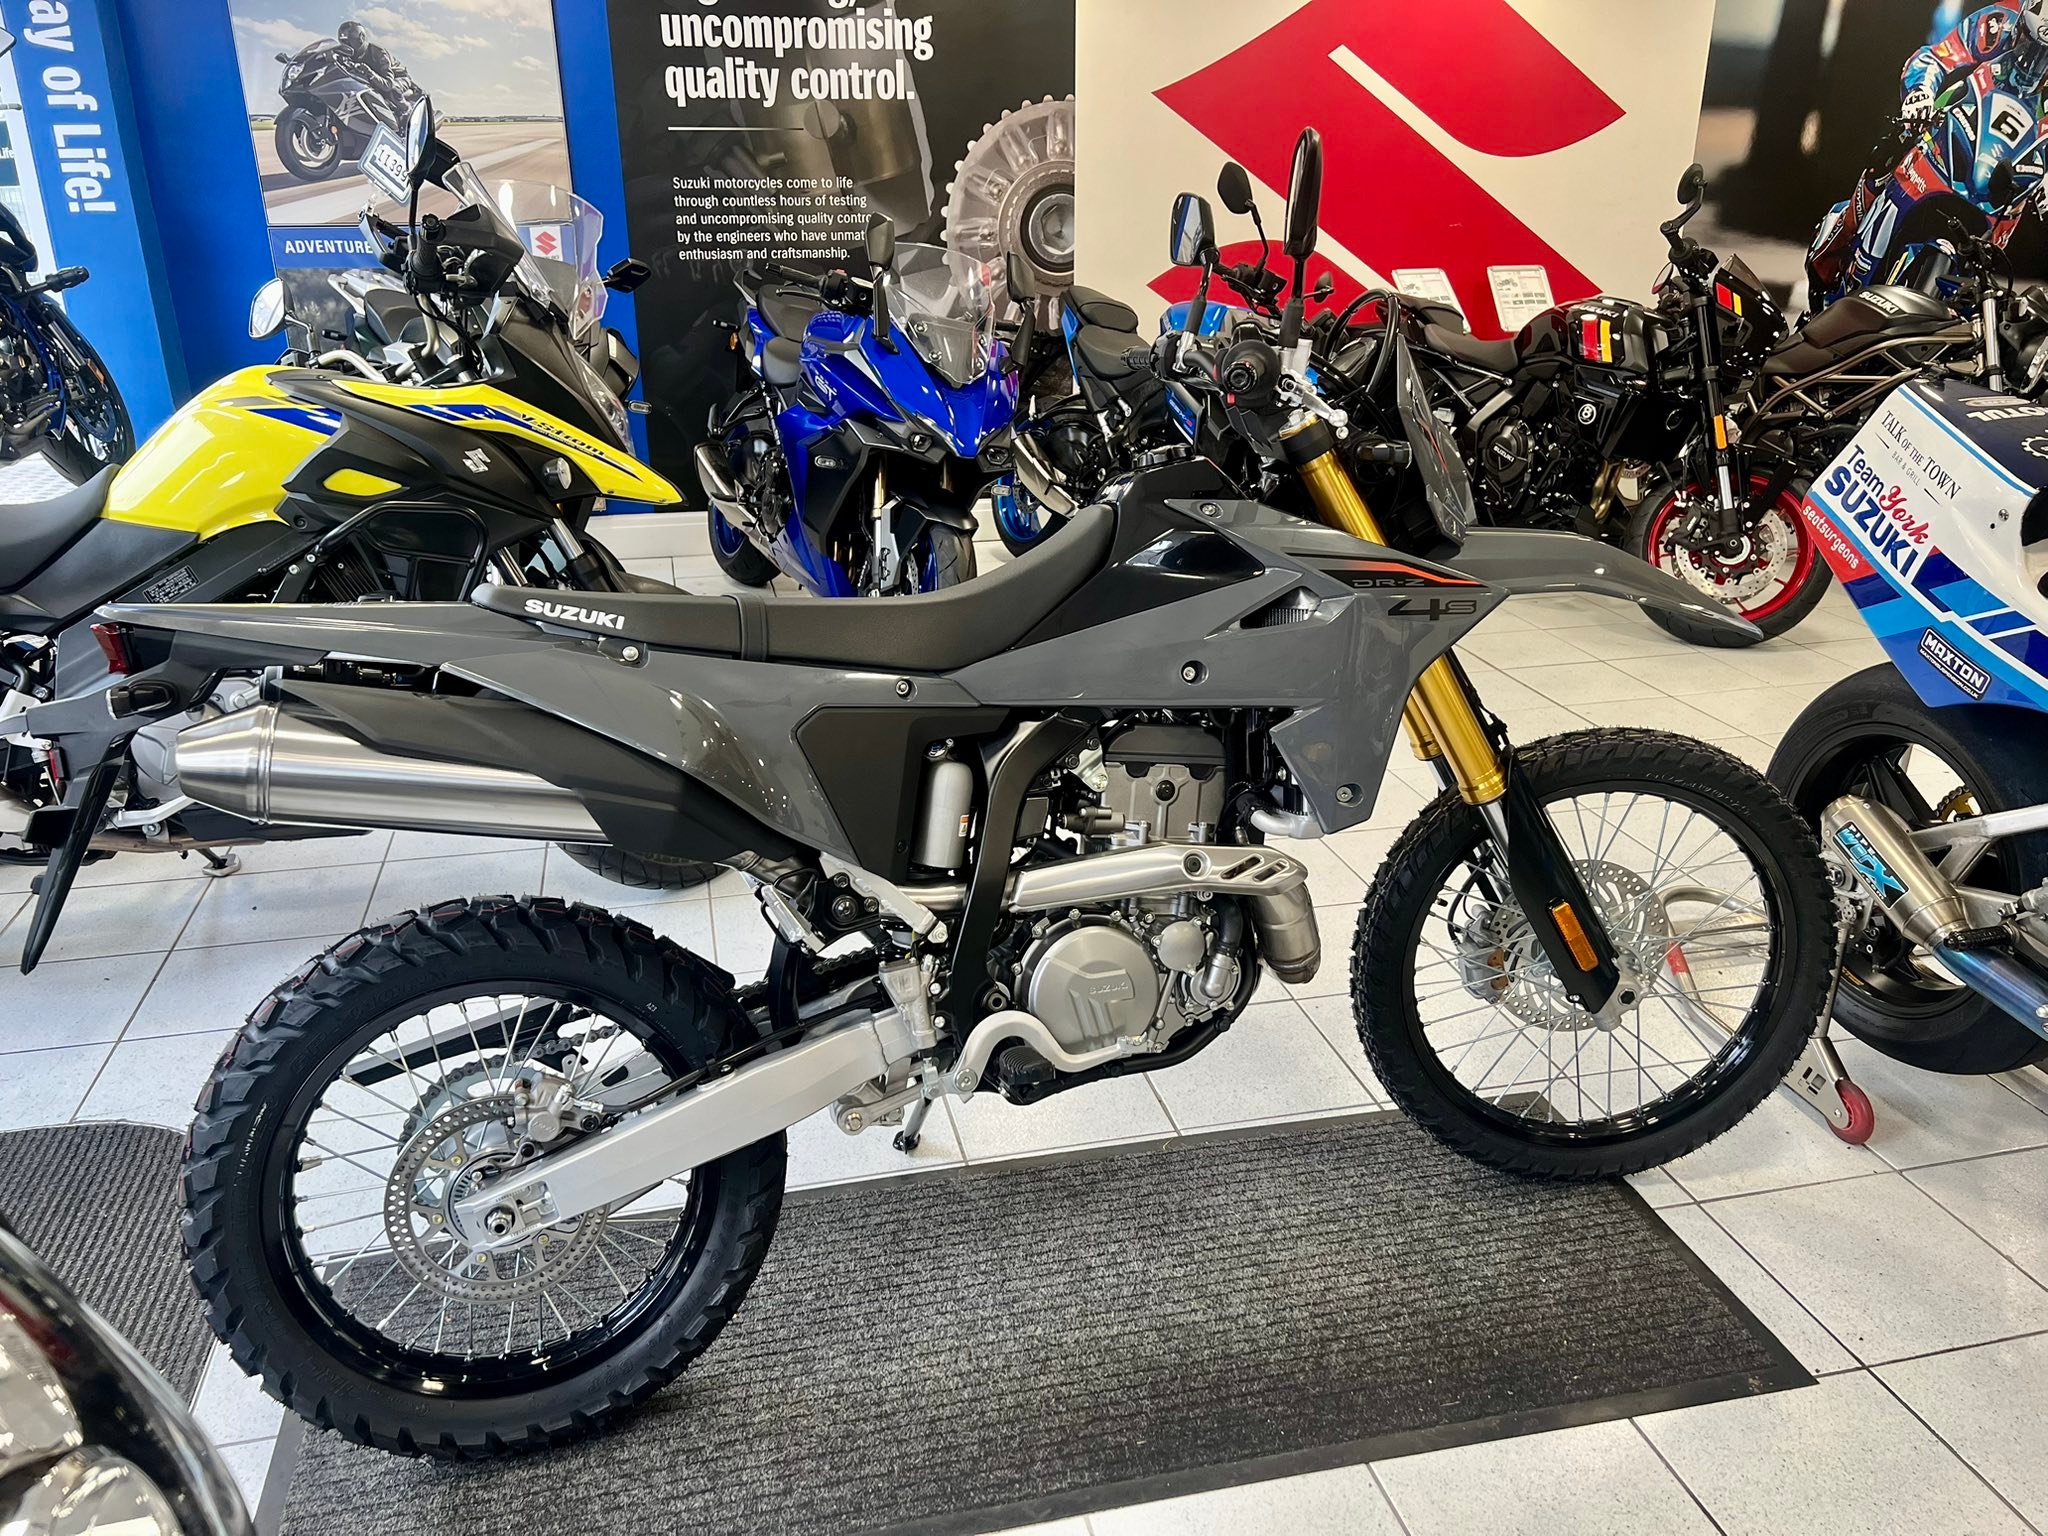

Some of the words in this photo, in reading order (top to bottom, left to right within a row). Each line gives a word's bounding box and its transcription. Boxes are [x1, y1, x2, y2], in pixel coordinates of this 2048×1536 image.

[24, 0, 74, 52] ay
[660, 8, 934, 60] uncompromising
[43, 66, 98, 111] of
[665, 57, 779, 107] quality
[791, 60, 914, 100] control.
[1991, 111, 2025, 141] 6
[52, 124, 117, 212] Life!
[673, 177, 710, 189] Suzuki
[714, 177, 783, 191] motorcycles
[787, 179, 817, 188] come
[821, 178, 832, 188] to
[836, 177, 853, 188] life
[674, 195, 718, 209] through
[722, 195, 776, 206] countless
[780, 195, 811, 206] hours
[815, 195, 826, 206] of
[830, 195, 866, 208] testing
[676, 213, 697, 224] and
[701, 213, 794, 226] uncompromising
[798, 213, 833, 225] quality
[285, 240, 373, 253] ADVENTURE
[677, 231, 690, 244] by
[694, 231, 712, 242] the
[716, 230, 770, 244] engineers
[774, 231, 797, 241] who
[801, 231, 827, 241] have
[831, 232, 865, 240] unmat
[679, 248, 743, 260] enthusiasm
[747, 248, 767, 259] and
[771, 247, 850, 260] craftsmanship.
[1571, 305, 1619, 318] SUZUKI
[1859, 291, 1898, 314] SUZUKI
[1493, 446, 1514, 462] SUZUKI
[1881, 410, 1907, 443] TALK
[1901, 438, 1912, 451] OF
[1910, 446, 1924, 466] THE
[1923, 457, 1962, 499] TOWN
[1892, 451, 1902, 465] BAR
[1906, 468, 1920, 486] GRILL
[1847, 444, 1884, 498] Team
[1879, 486, 1929, 544] York
[1825, 466, 1918, 577] SUZUKI
[1803, 506, 1859, 569] seatsurgeons
[1352, 579, 1424, 587] DR-Z
[524, 599, 625, 630] SUZUKI
[1388, 599, 1477, 621] 4S
[1925, 635, 1984, 688] MAXTON
